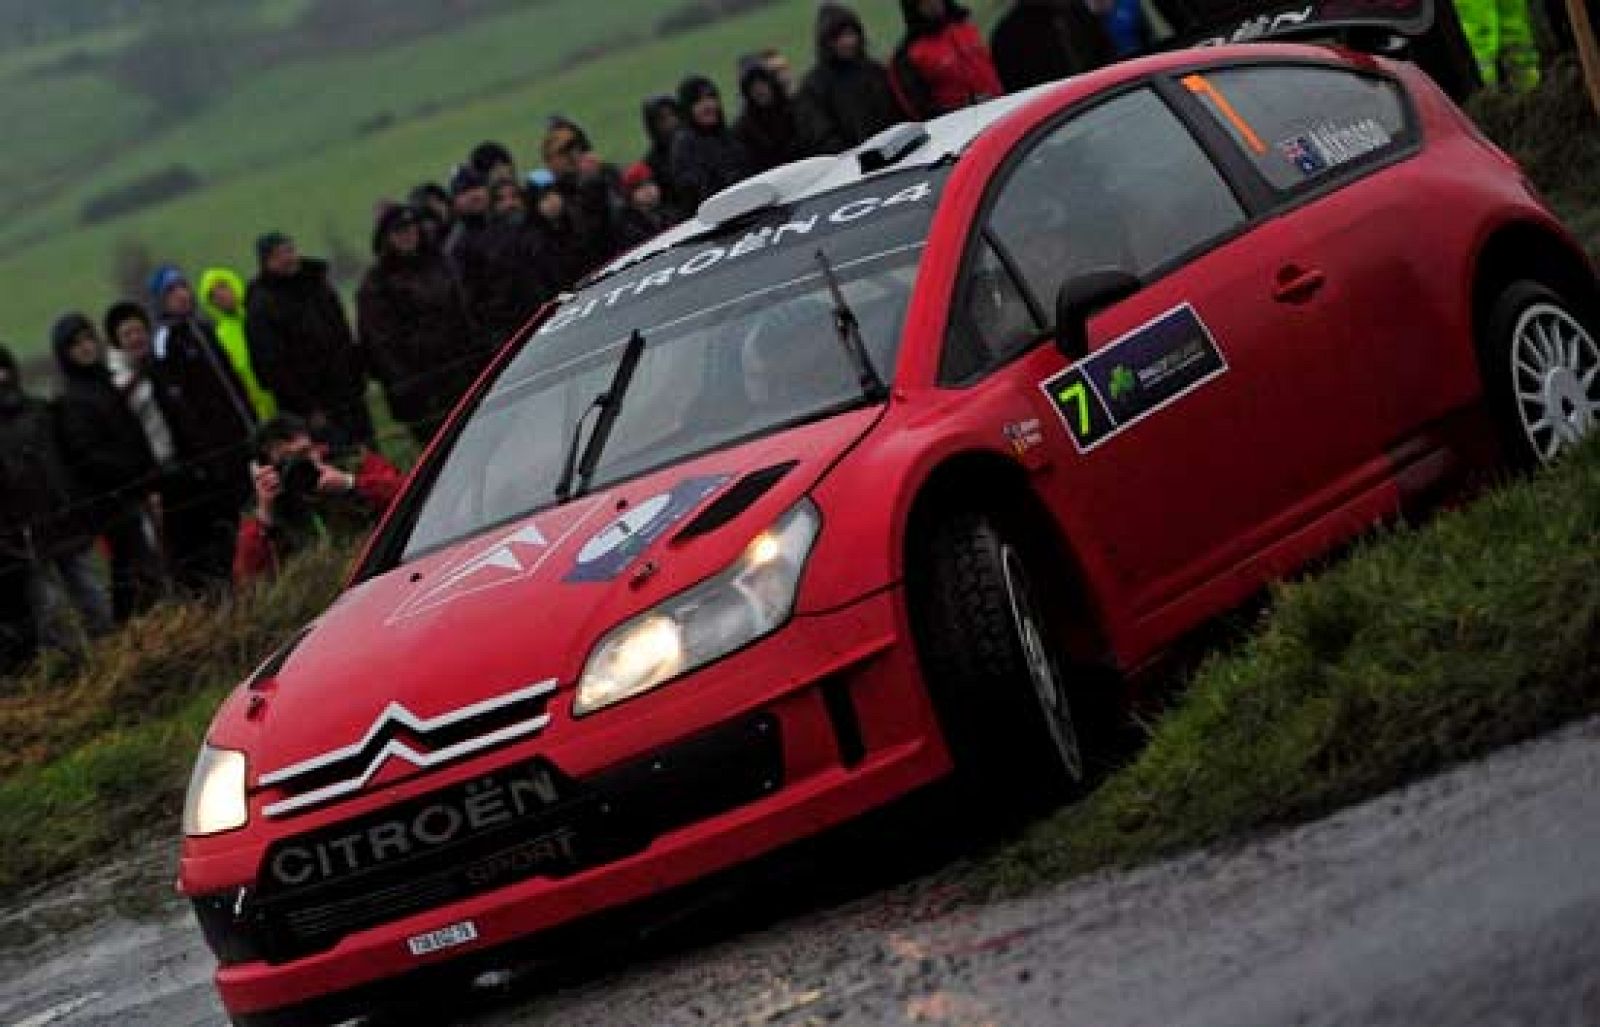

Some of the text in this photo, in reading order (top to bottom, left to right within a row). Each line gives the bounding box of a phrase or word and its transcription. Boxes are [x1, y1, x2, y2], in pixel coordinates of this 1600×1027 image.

[829, 182, 931, 224] C4
[1058, 381, 1089, 435] 7
[272, 768, 560, 884] CITROËN
